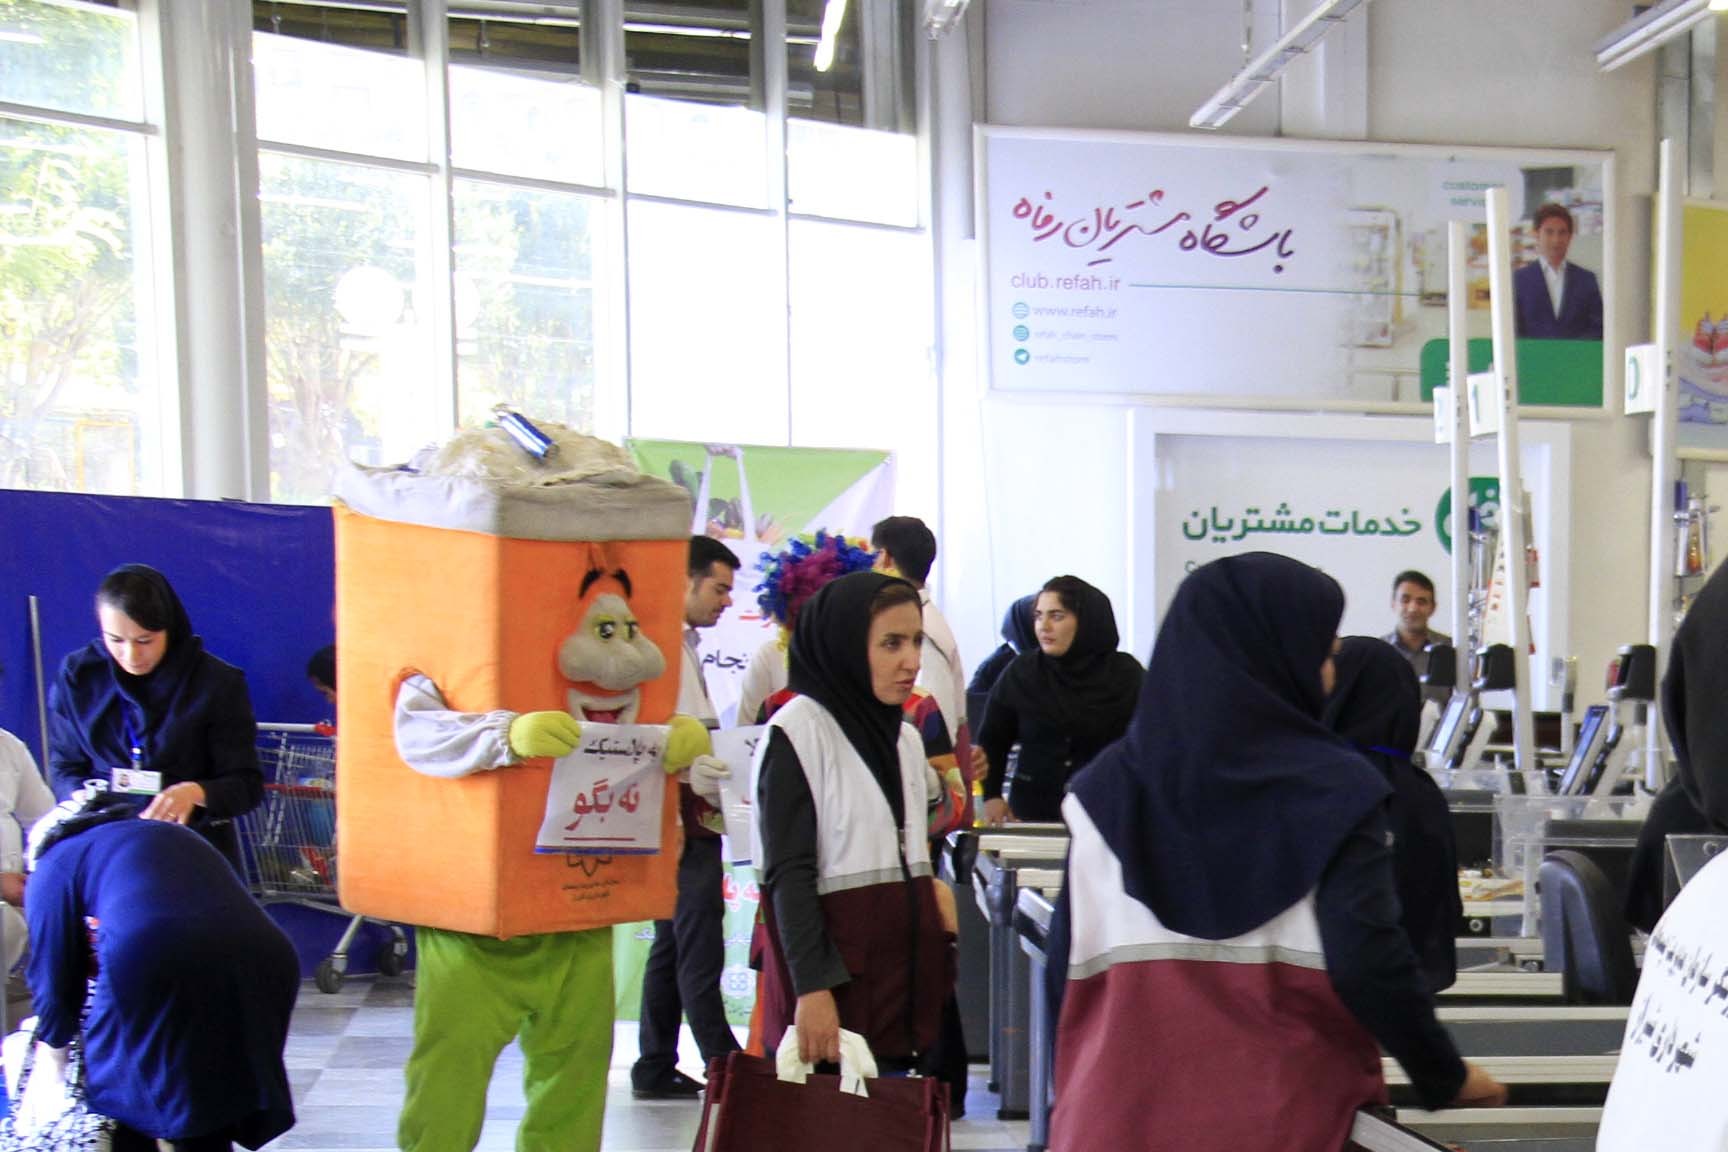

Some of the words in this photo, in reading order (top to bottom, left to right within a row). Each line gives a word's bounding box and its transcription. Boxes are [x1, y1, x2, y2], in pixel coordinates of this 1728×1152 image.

[1012, 191, 1064, 242] رفاه
[1063, 189, 1191, 266] مشتریان
[1178, 187, 1294, 274] باشگاه
[1010, 272, 1121, 292] club.refah.ir
[1181, 502, 1314, 543] مشتریان
[1319, 507, 1423, 537] خدمات
[564, 778, 615, 832] بگو
